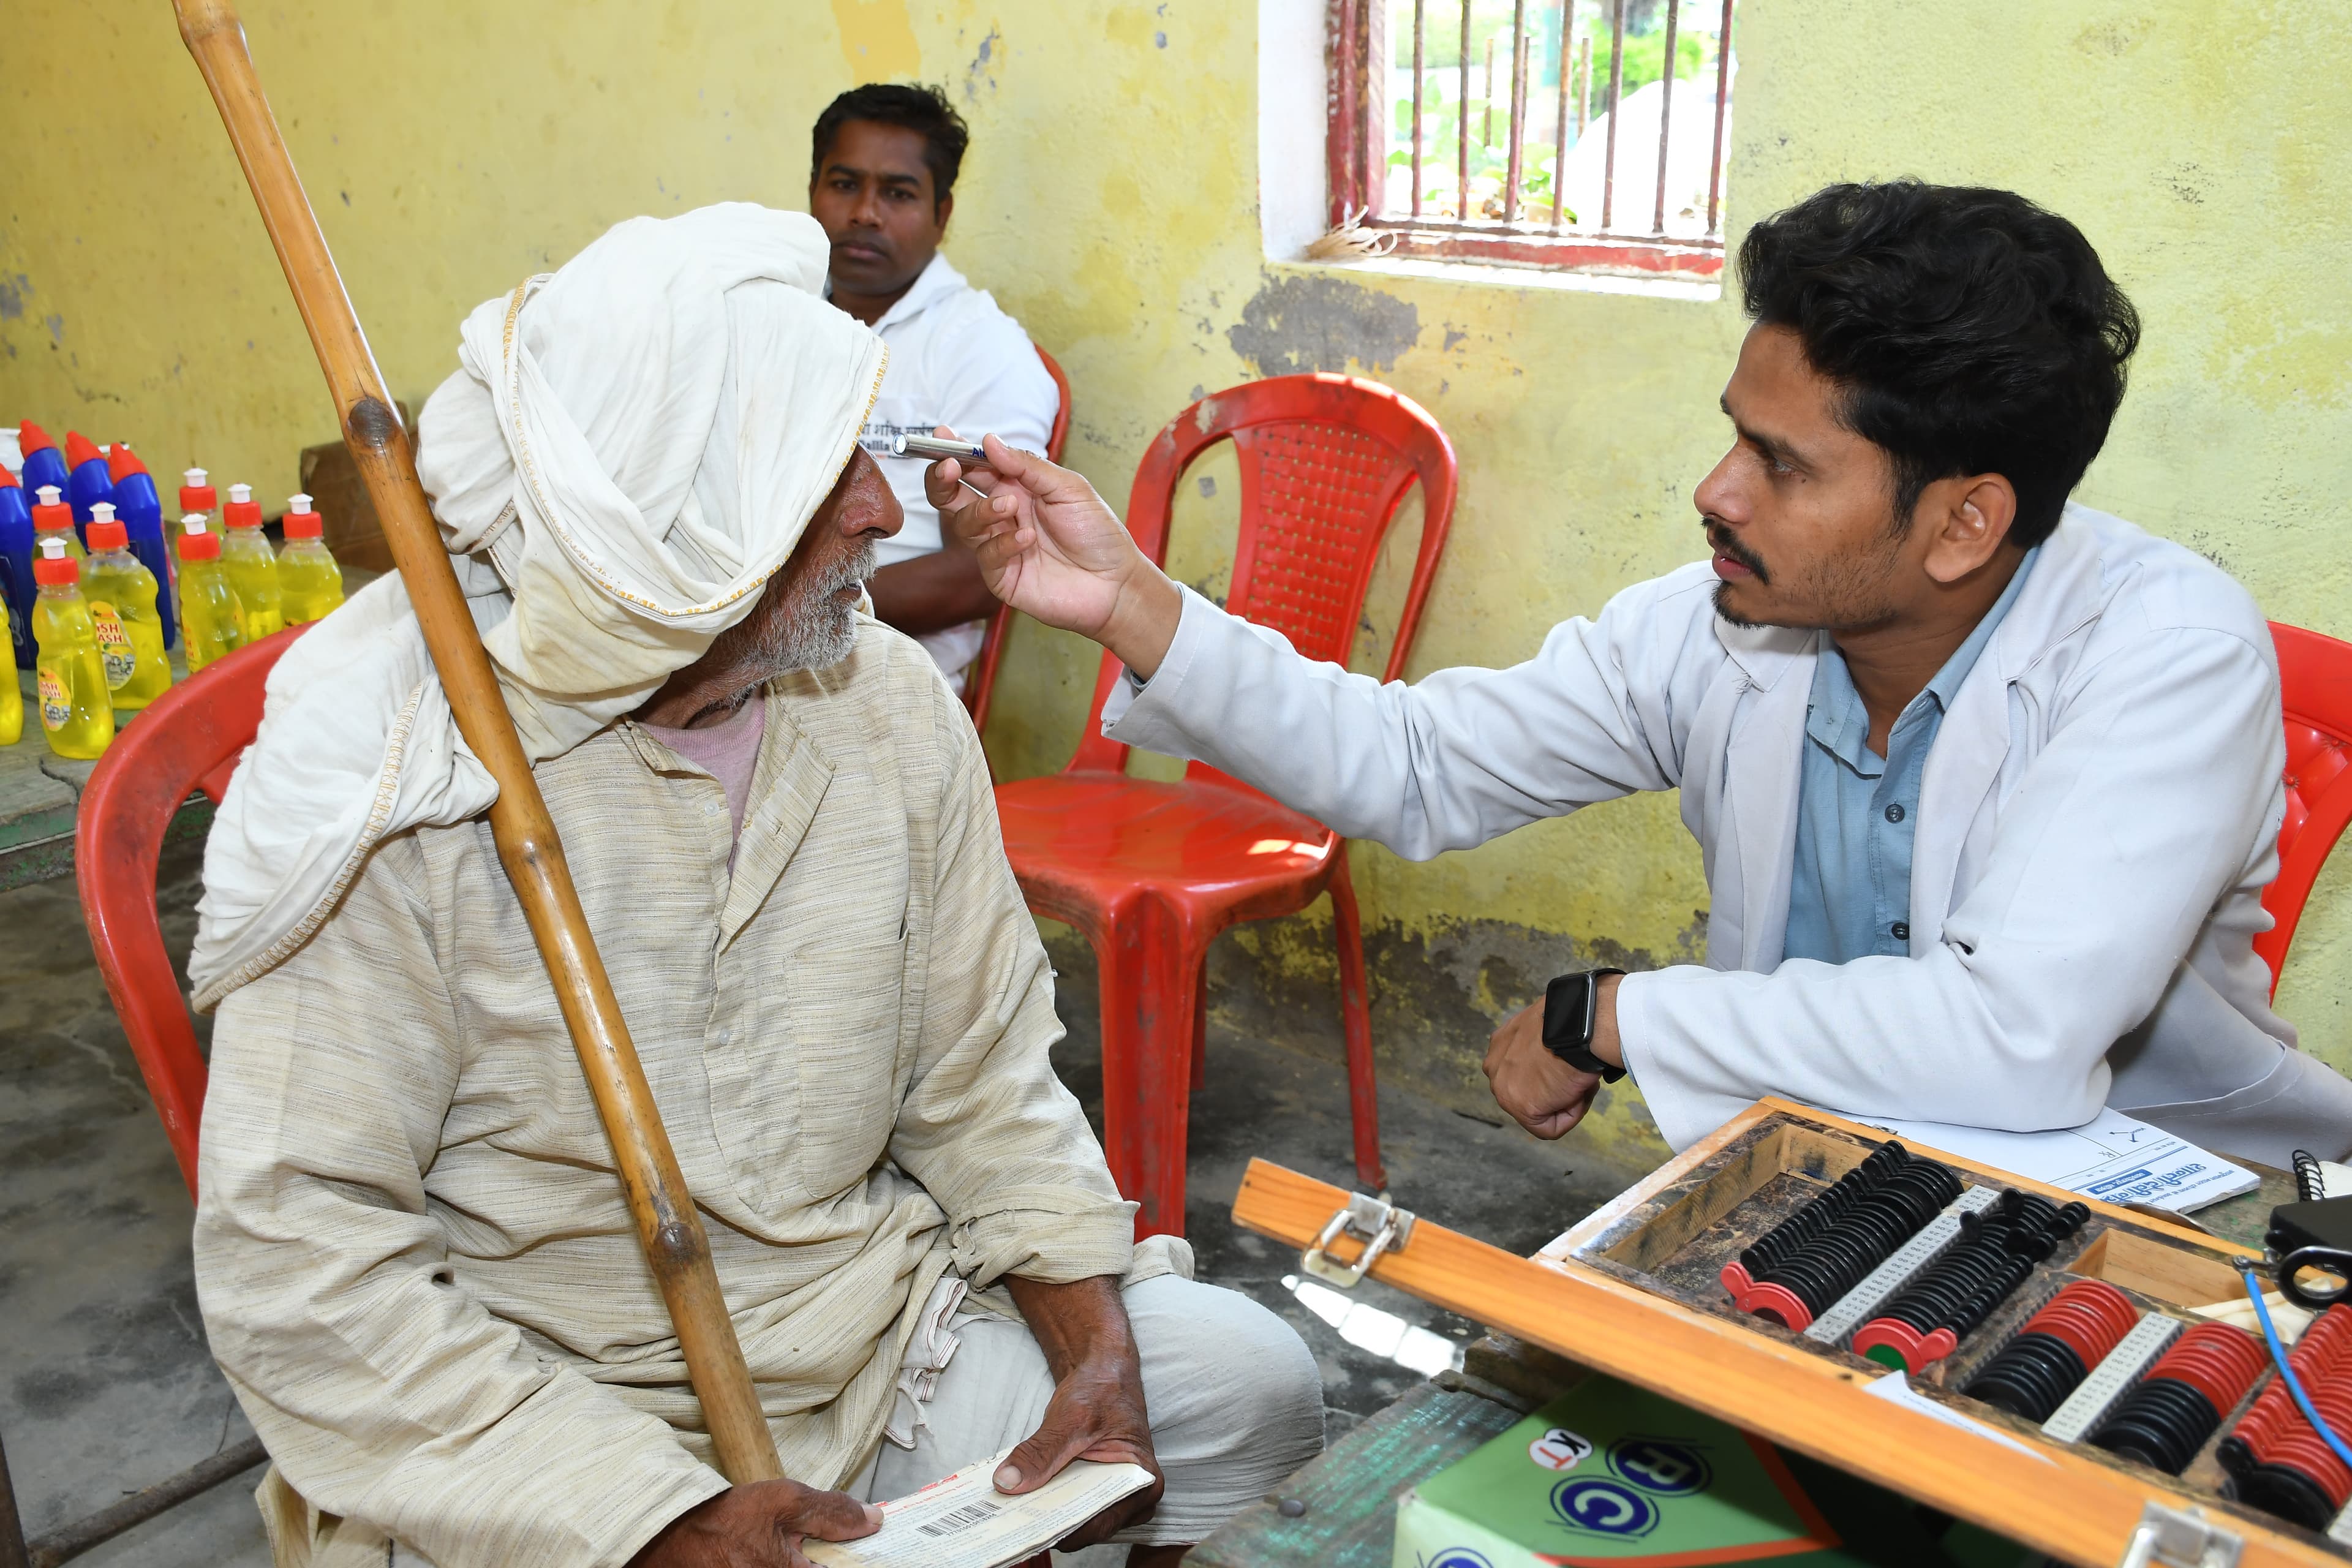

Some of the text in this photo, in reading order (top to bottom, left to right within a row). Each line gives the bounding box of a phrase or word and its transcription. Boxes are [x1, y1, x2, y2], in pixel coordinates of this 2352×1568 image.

[97, 624, 118, 633] ISH
[98, 634, 122, 643] ASH
[2131, 1181, 2163, 1196] देवी
[1934, 1224, 1953, 1233] 2.00
[1910, 1246, 1928, 1254] 3.00
[1897, 1257, 1916, 1265] 4.00
[1891, 1262, 1910, 1271] 4.50
